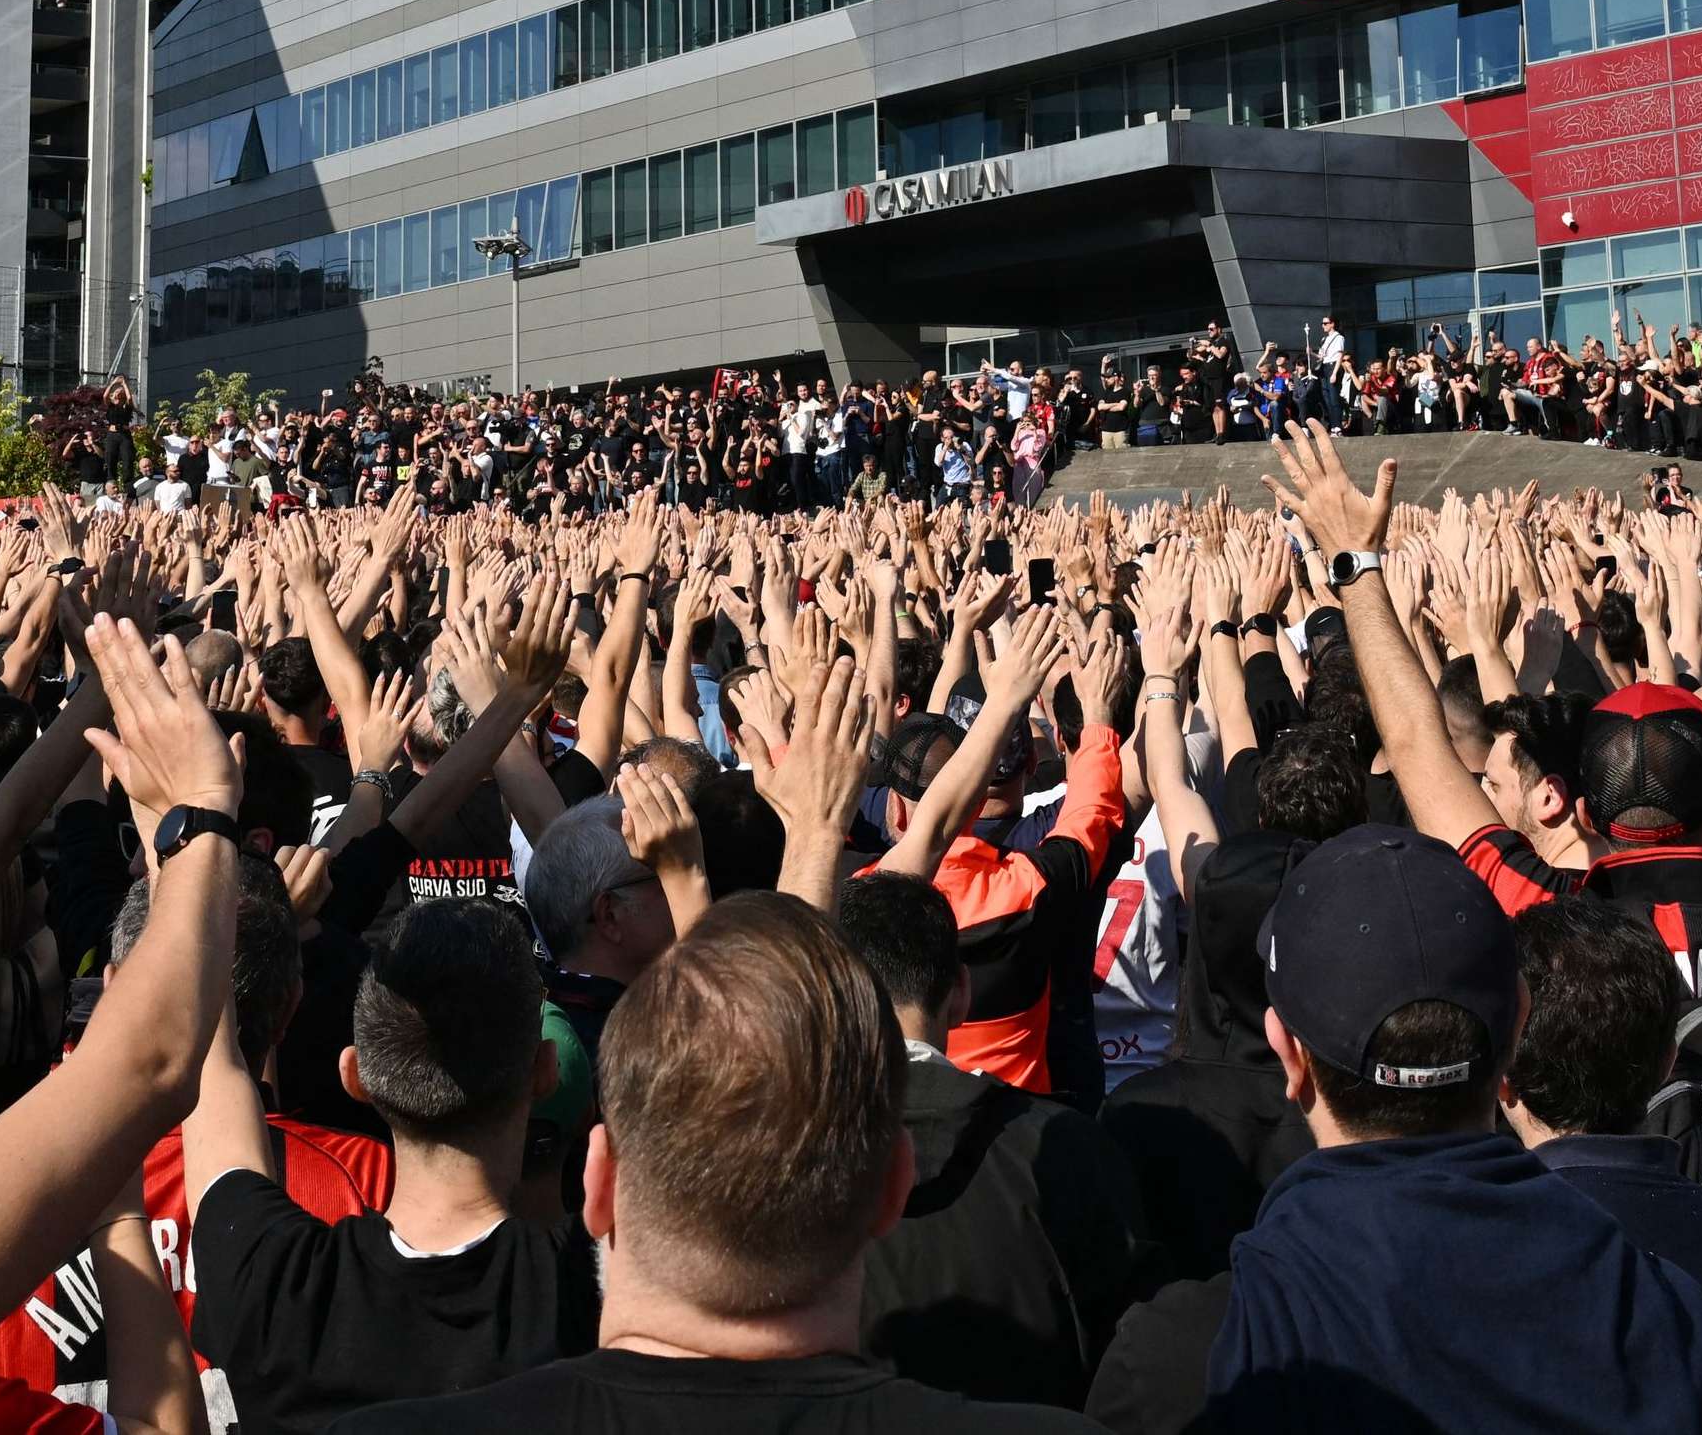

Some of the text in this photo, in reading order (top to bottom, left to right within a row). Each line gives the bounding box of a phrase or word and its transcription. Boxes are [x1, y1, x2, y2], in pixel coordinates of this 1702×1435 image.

[875, 159, 1014, 219] CASA MILAN
[408, 876, 487, 897] CURVA SUD
[1407, 1068, 1463, 1084] RED SOX
